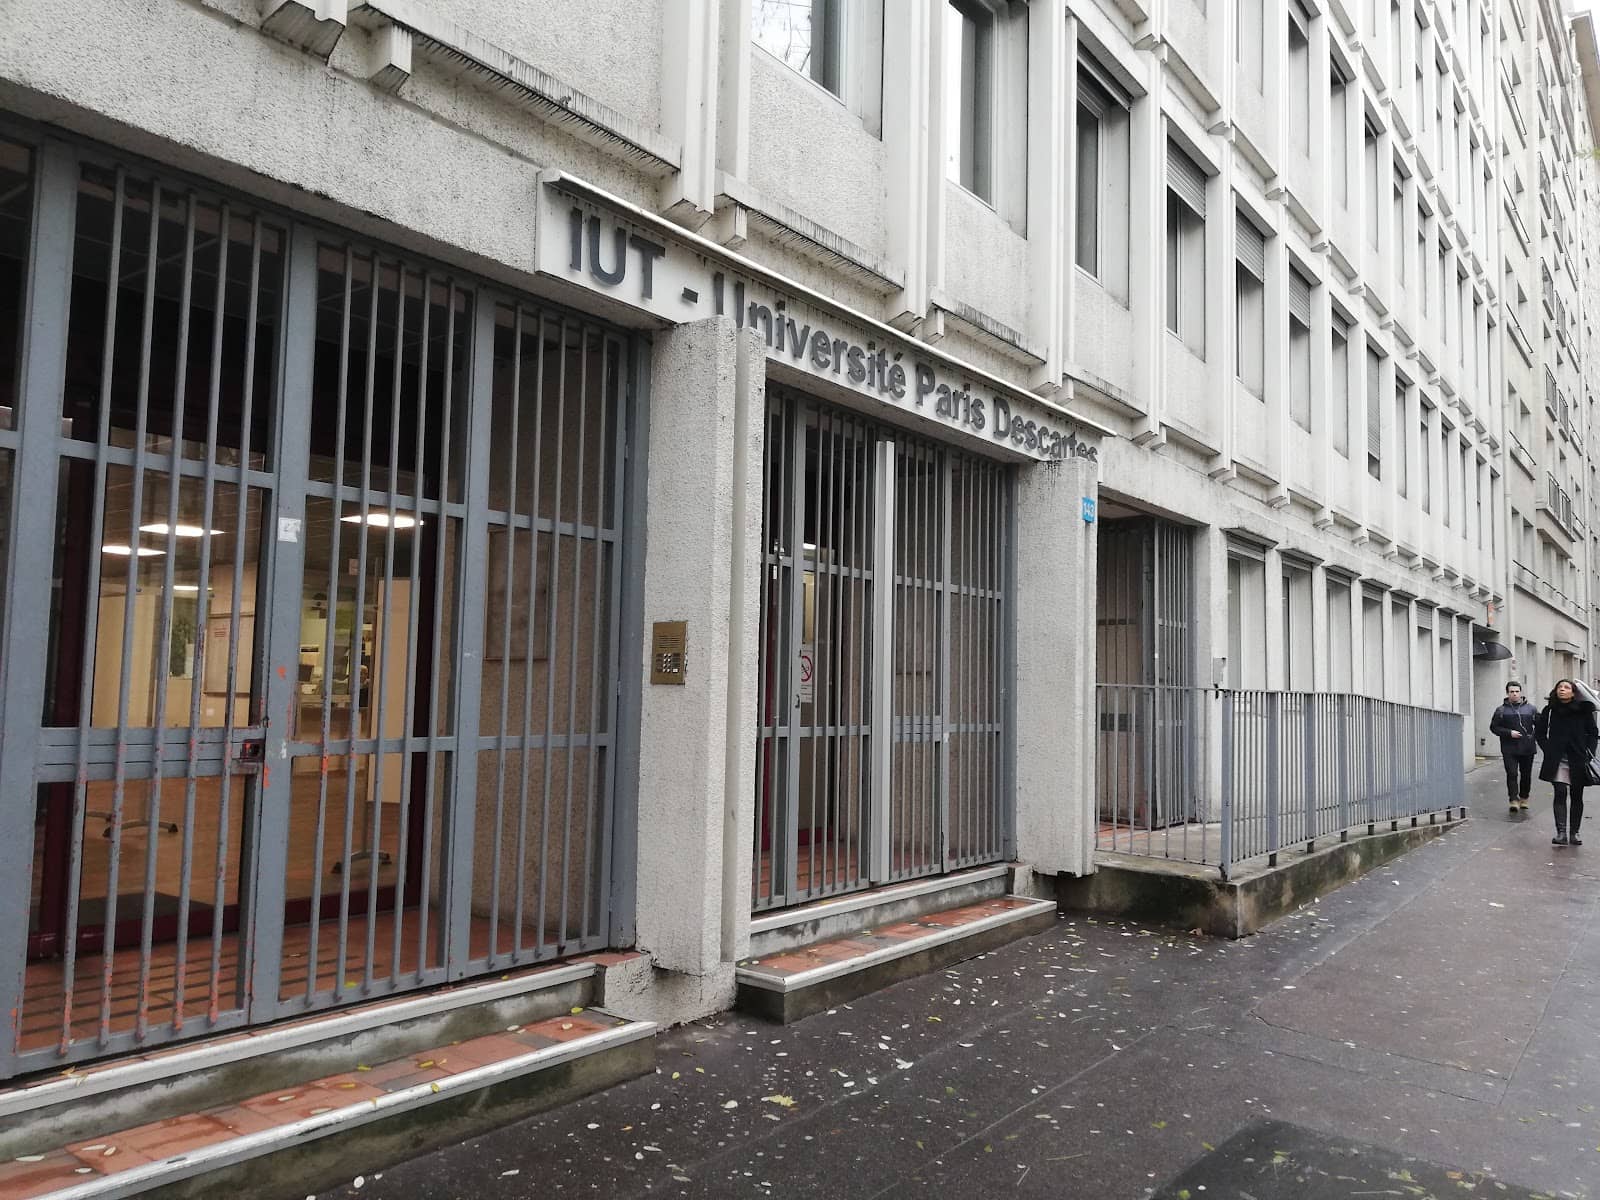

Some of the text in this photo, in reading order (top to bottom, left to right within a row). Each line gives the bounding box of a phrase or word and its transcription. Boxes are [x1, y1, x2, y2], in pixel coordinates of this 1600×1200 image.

[569, 206, 666, 300] IUT
[713, 270, 907, 400] Université
[915, 361, 987, 430] Paris
